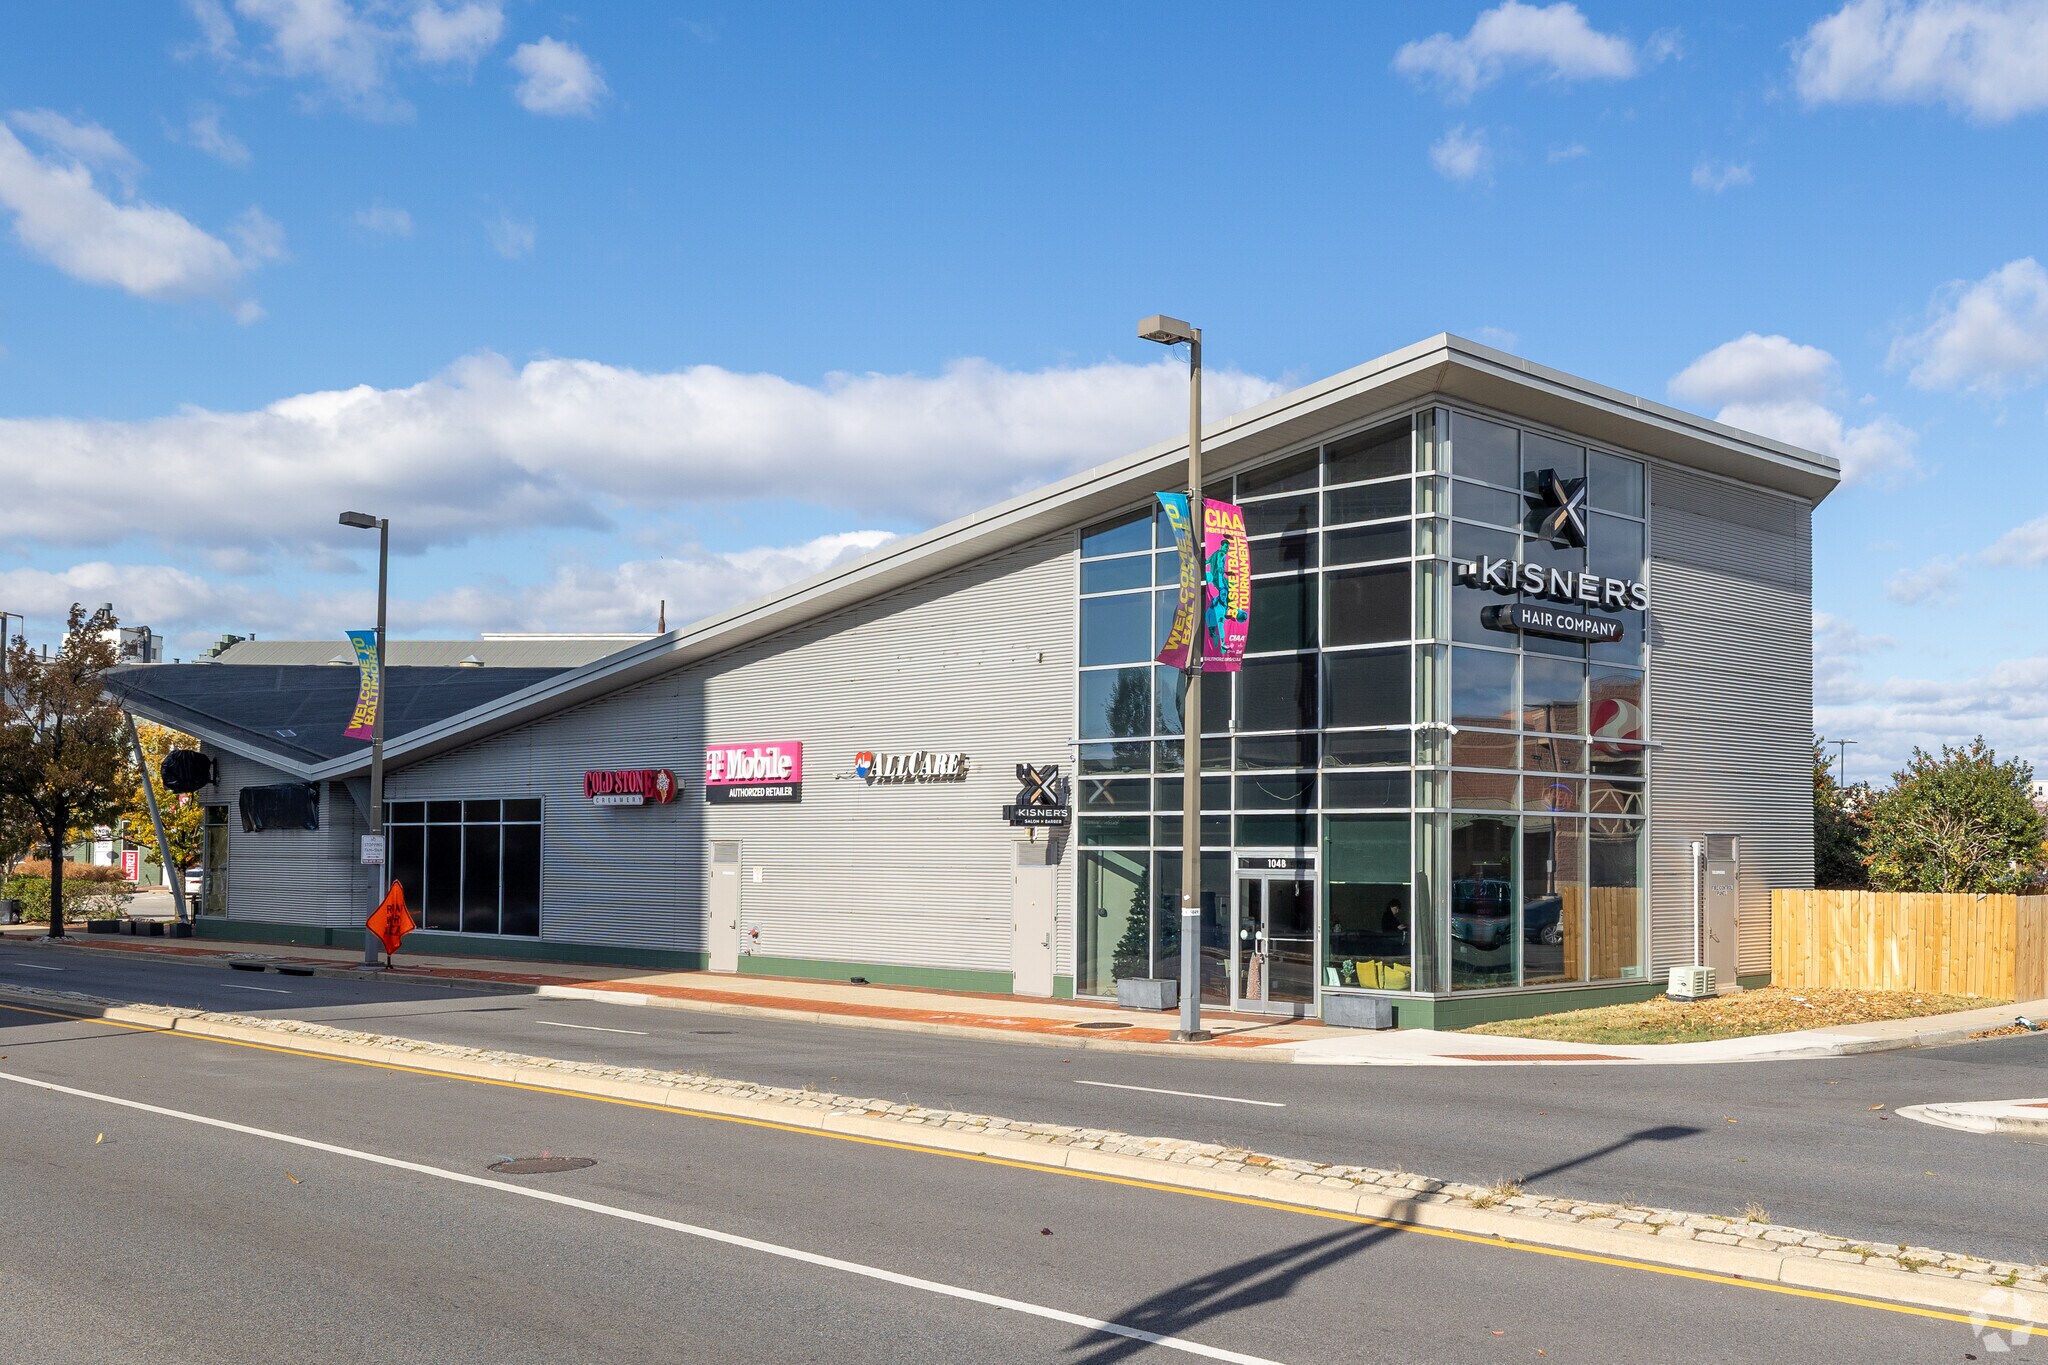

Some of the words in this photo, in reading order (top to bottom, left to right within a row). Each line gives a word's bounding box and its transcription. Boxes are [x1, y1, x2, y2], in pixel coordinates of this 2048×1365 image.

[1165, 504, 1182, 531] TO
[1205, 508, 1245, 531] CIAA
[1181, 517, 1196, 645] BALTIMORE
[1226, 536, 1239, 618] BASKETBALL
[1237, 537, 1250, 610] TOURNAMENT
[1482, 555, 1649, 612] KISNER'S
[1164, 538, 1189, 650] WELCOME
[1522, 609, 1553, 627] HAIR
[1556, 615, 1617, 637] COMPANY
[352, 638, 368, 656] TO
[348, 659, 371, 729] WELCOME
[364, 645, 379, 726] BALTIMORE
[584, 770, 614, 798] COLD
[615, 769, 655, 797] STONE
[729, 788, 765, 798] AUTHORIZED
[765, 786, 793, 796] RETAILER
[1018, 808, 1069, 817] KISNER'S
[1267, 859, 1287, 868] 104B
